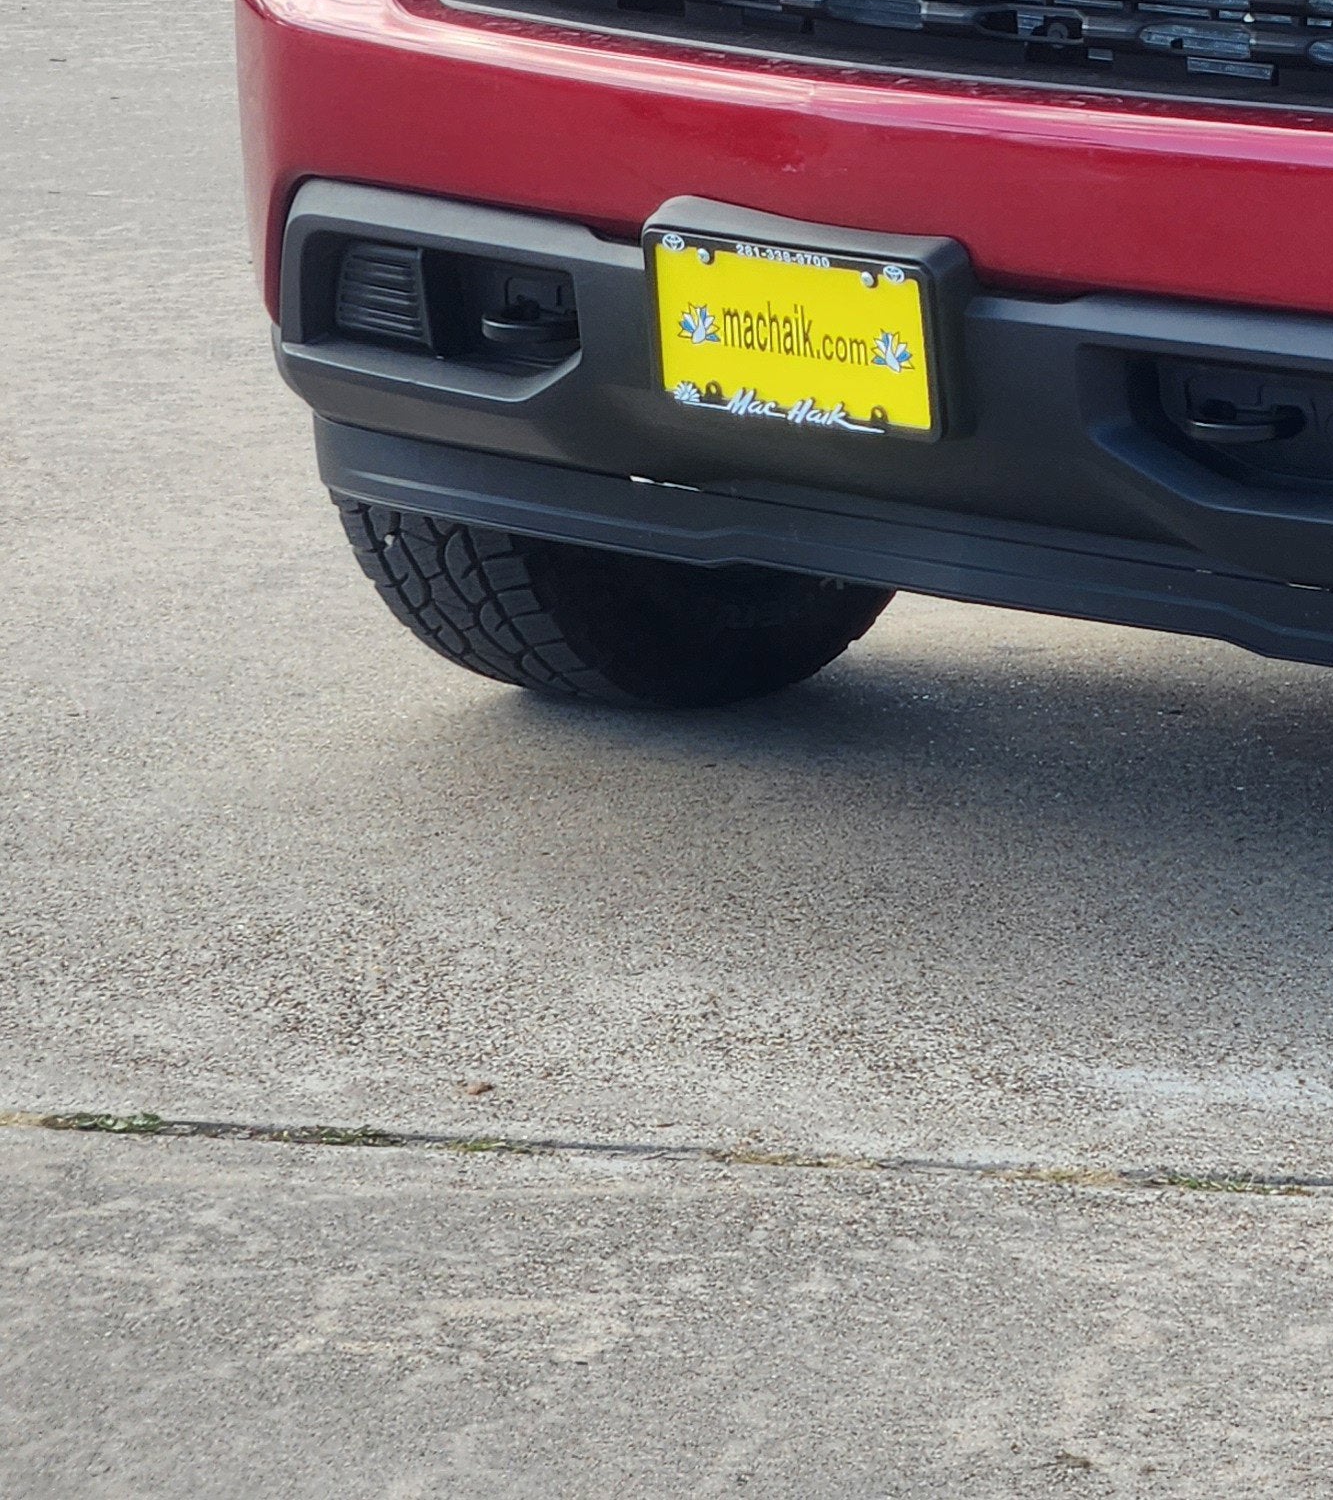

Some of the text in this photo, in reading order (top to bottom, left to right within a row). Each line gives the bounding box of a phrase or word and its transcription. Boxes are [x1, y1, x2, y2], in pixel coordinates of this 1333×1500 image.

[722, 302, 869, 366] machaik.com
[726, 387, 868, 431] Mac Haik
